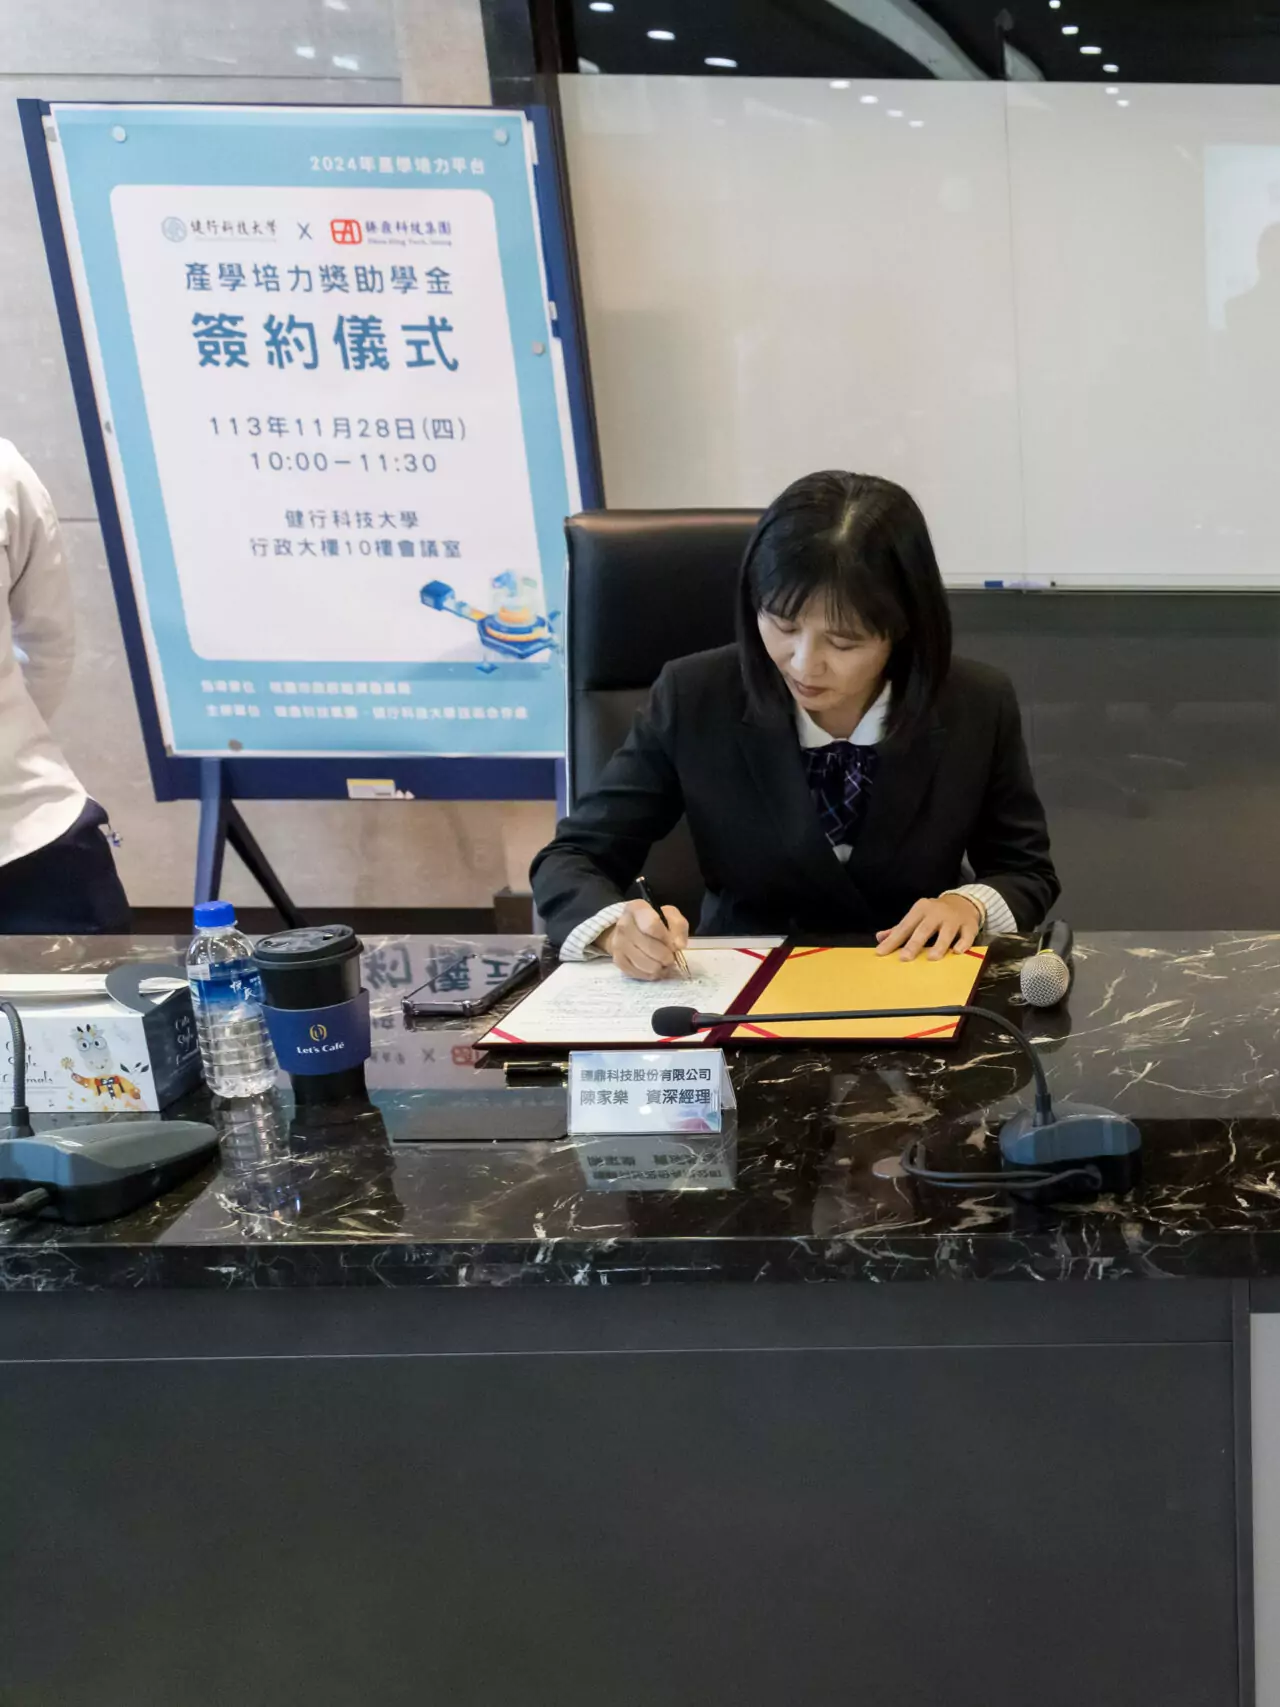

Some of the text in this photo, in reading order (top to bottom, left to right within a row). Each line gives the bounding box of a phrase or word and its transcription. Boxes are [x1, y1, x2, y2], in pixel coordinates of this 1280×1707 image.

[185, 262, 453, 295] 產學培力獎助學金
[191, 312, 459, 372] 簽約儀式
[209, 415, 466, 441] 113年11月28日(四)
[284, 509, 419, 529] 健行科技大學
[297, 1041, 345, 1054] Let's Café
[580, 1088, 711, 1105] 陳家樂 資深經理
